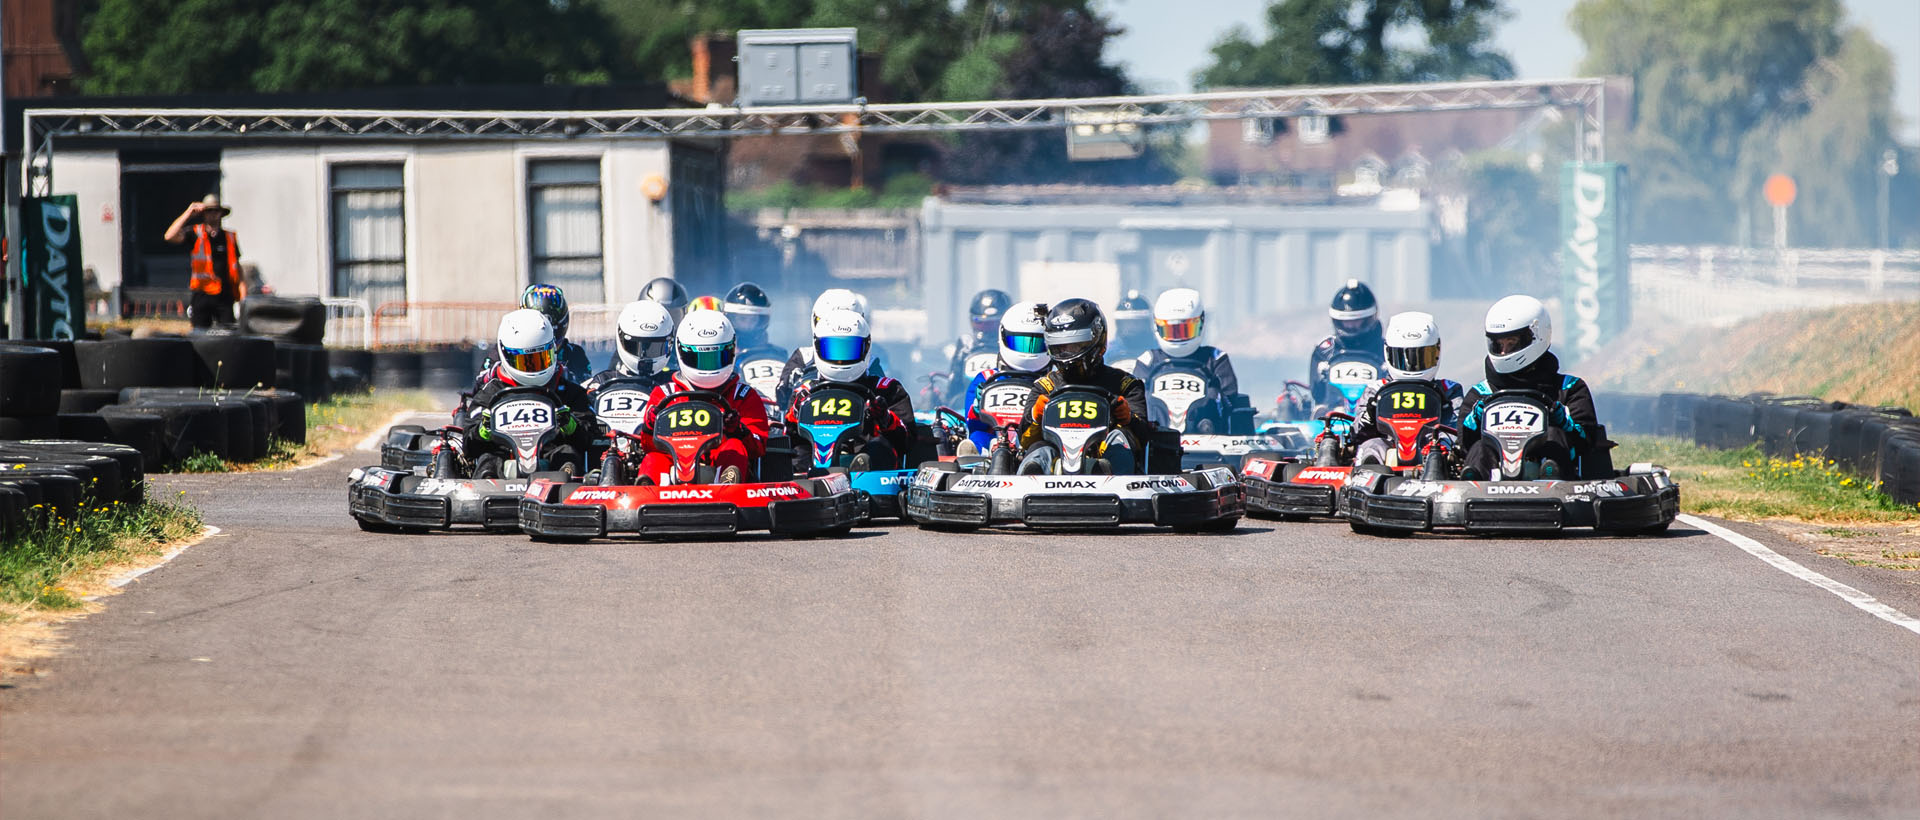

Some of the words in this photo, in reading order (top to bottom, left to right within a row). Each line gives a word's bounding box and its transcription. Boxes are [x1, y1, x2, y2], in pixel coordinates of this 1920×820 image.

[41, 201, 74, 341] DAYTO
[970, 361, 991, 371] 14
[1336, 369, 1373, 380] 143
[1158, 379, 1201, 393] 138
[603, 397, 648, 413] 137
[1391, 392, 1426, 410] 131
[811, 398, 852, 417] 142
[1057, 400, 1098, 420] 135
[499, 408, 549, 427] 148
[668, 409, 711, 429] 130
[1490, 410, 1540, 427] 147
[880, 475, 916, 485] DAYTO
[1299, 470, 1345, 481] DAYTONA
[505, 484, 528, 492] DM
[957, 480, 1001, 489] DAYTONA
[1045, 481, 1097, 489] DMAX
[1131, 479, 1181, 490] DAYTONA
[1487, 485, 1540, 494] DMAX
[1574, 481, 1624, 493] DAYTONA
[570, 490, 617, 500] DAYTONA
[659, 490, 713, 500] DMAX
[746, 486, 799, 498] DAYTONA
